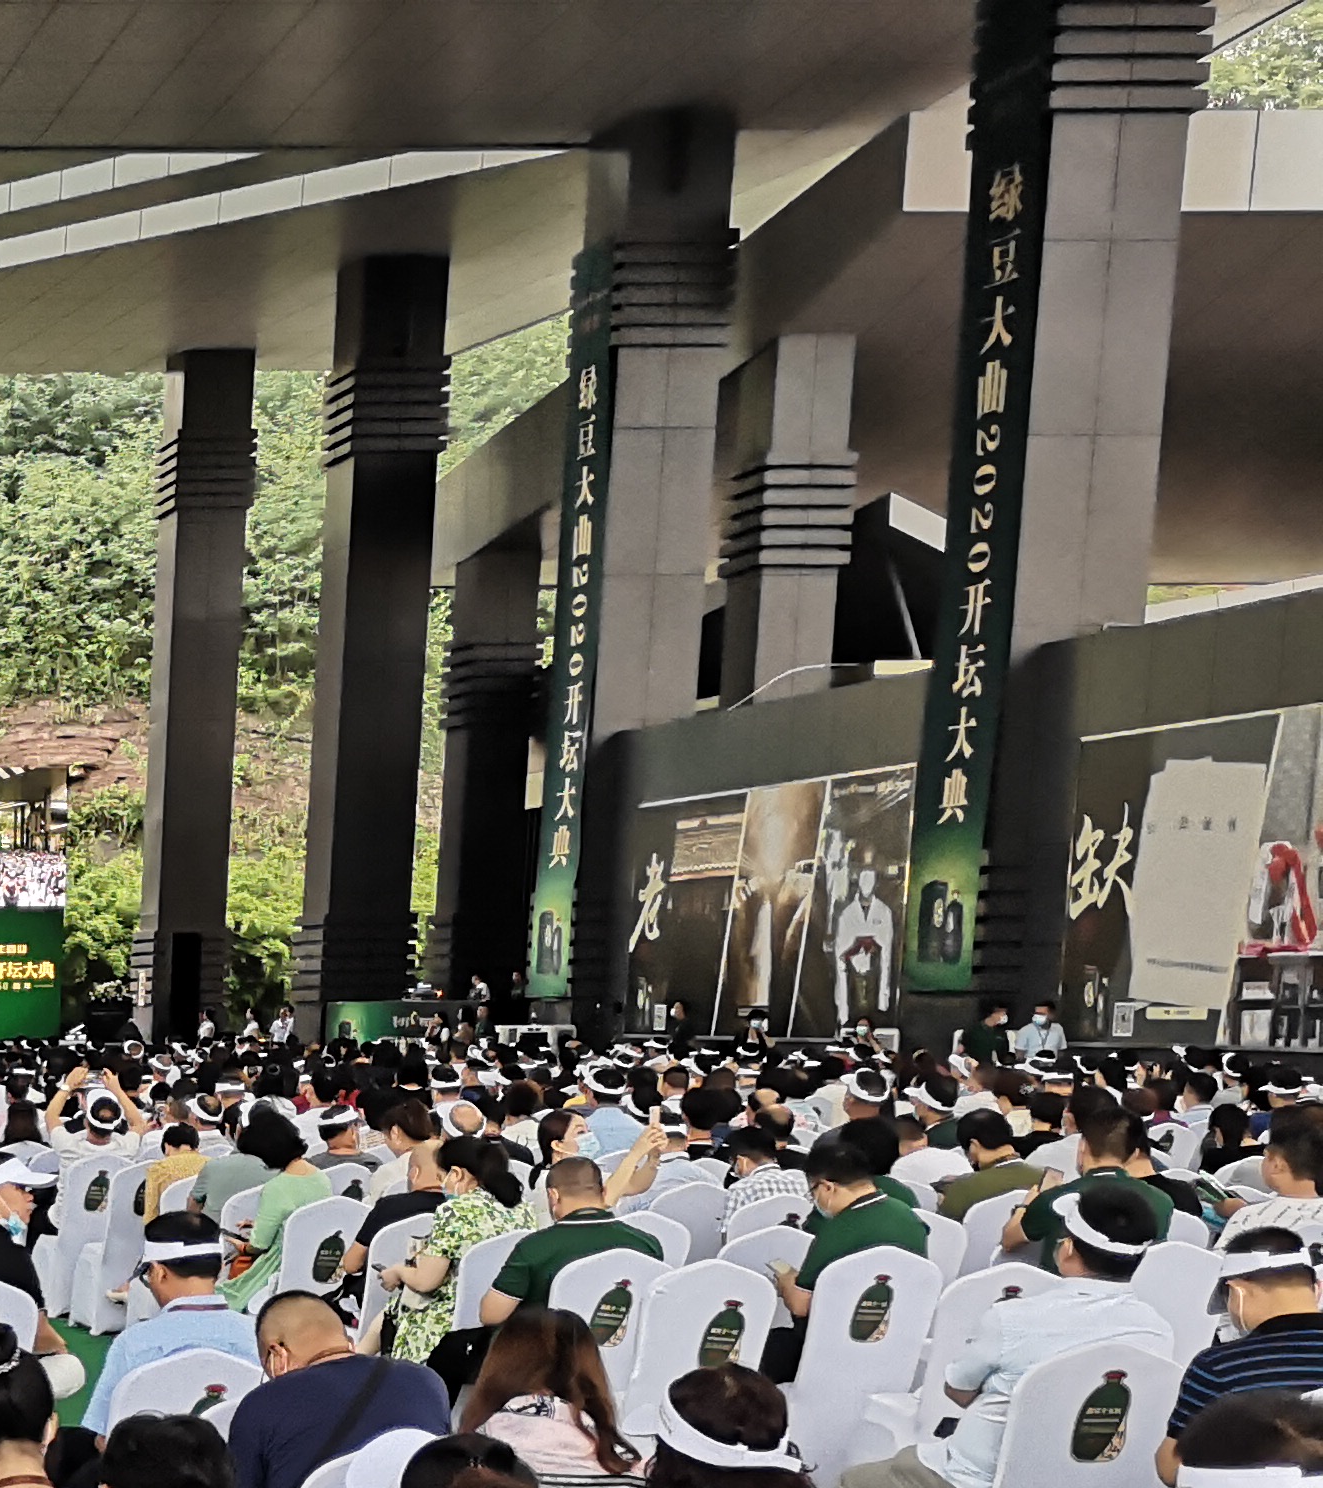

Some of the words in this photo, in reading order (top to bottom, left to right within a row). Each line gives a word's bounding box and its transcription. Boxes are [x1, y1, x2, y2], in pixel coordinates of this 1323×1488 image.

[548, 364, 597, 869] 绿豆大曲2020开坛大典
[937, 160, 1024, 824] 绿豆大曲2020开坛大典
